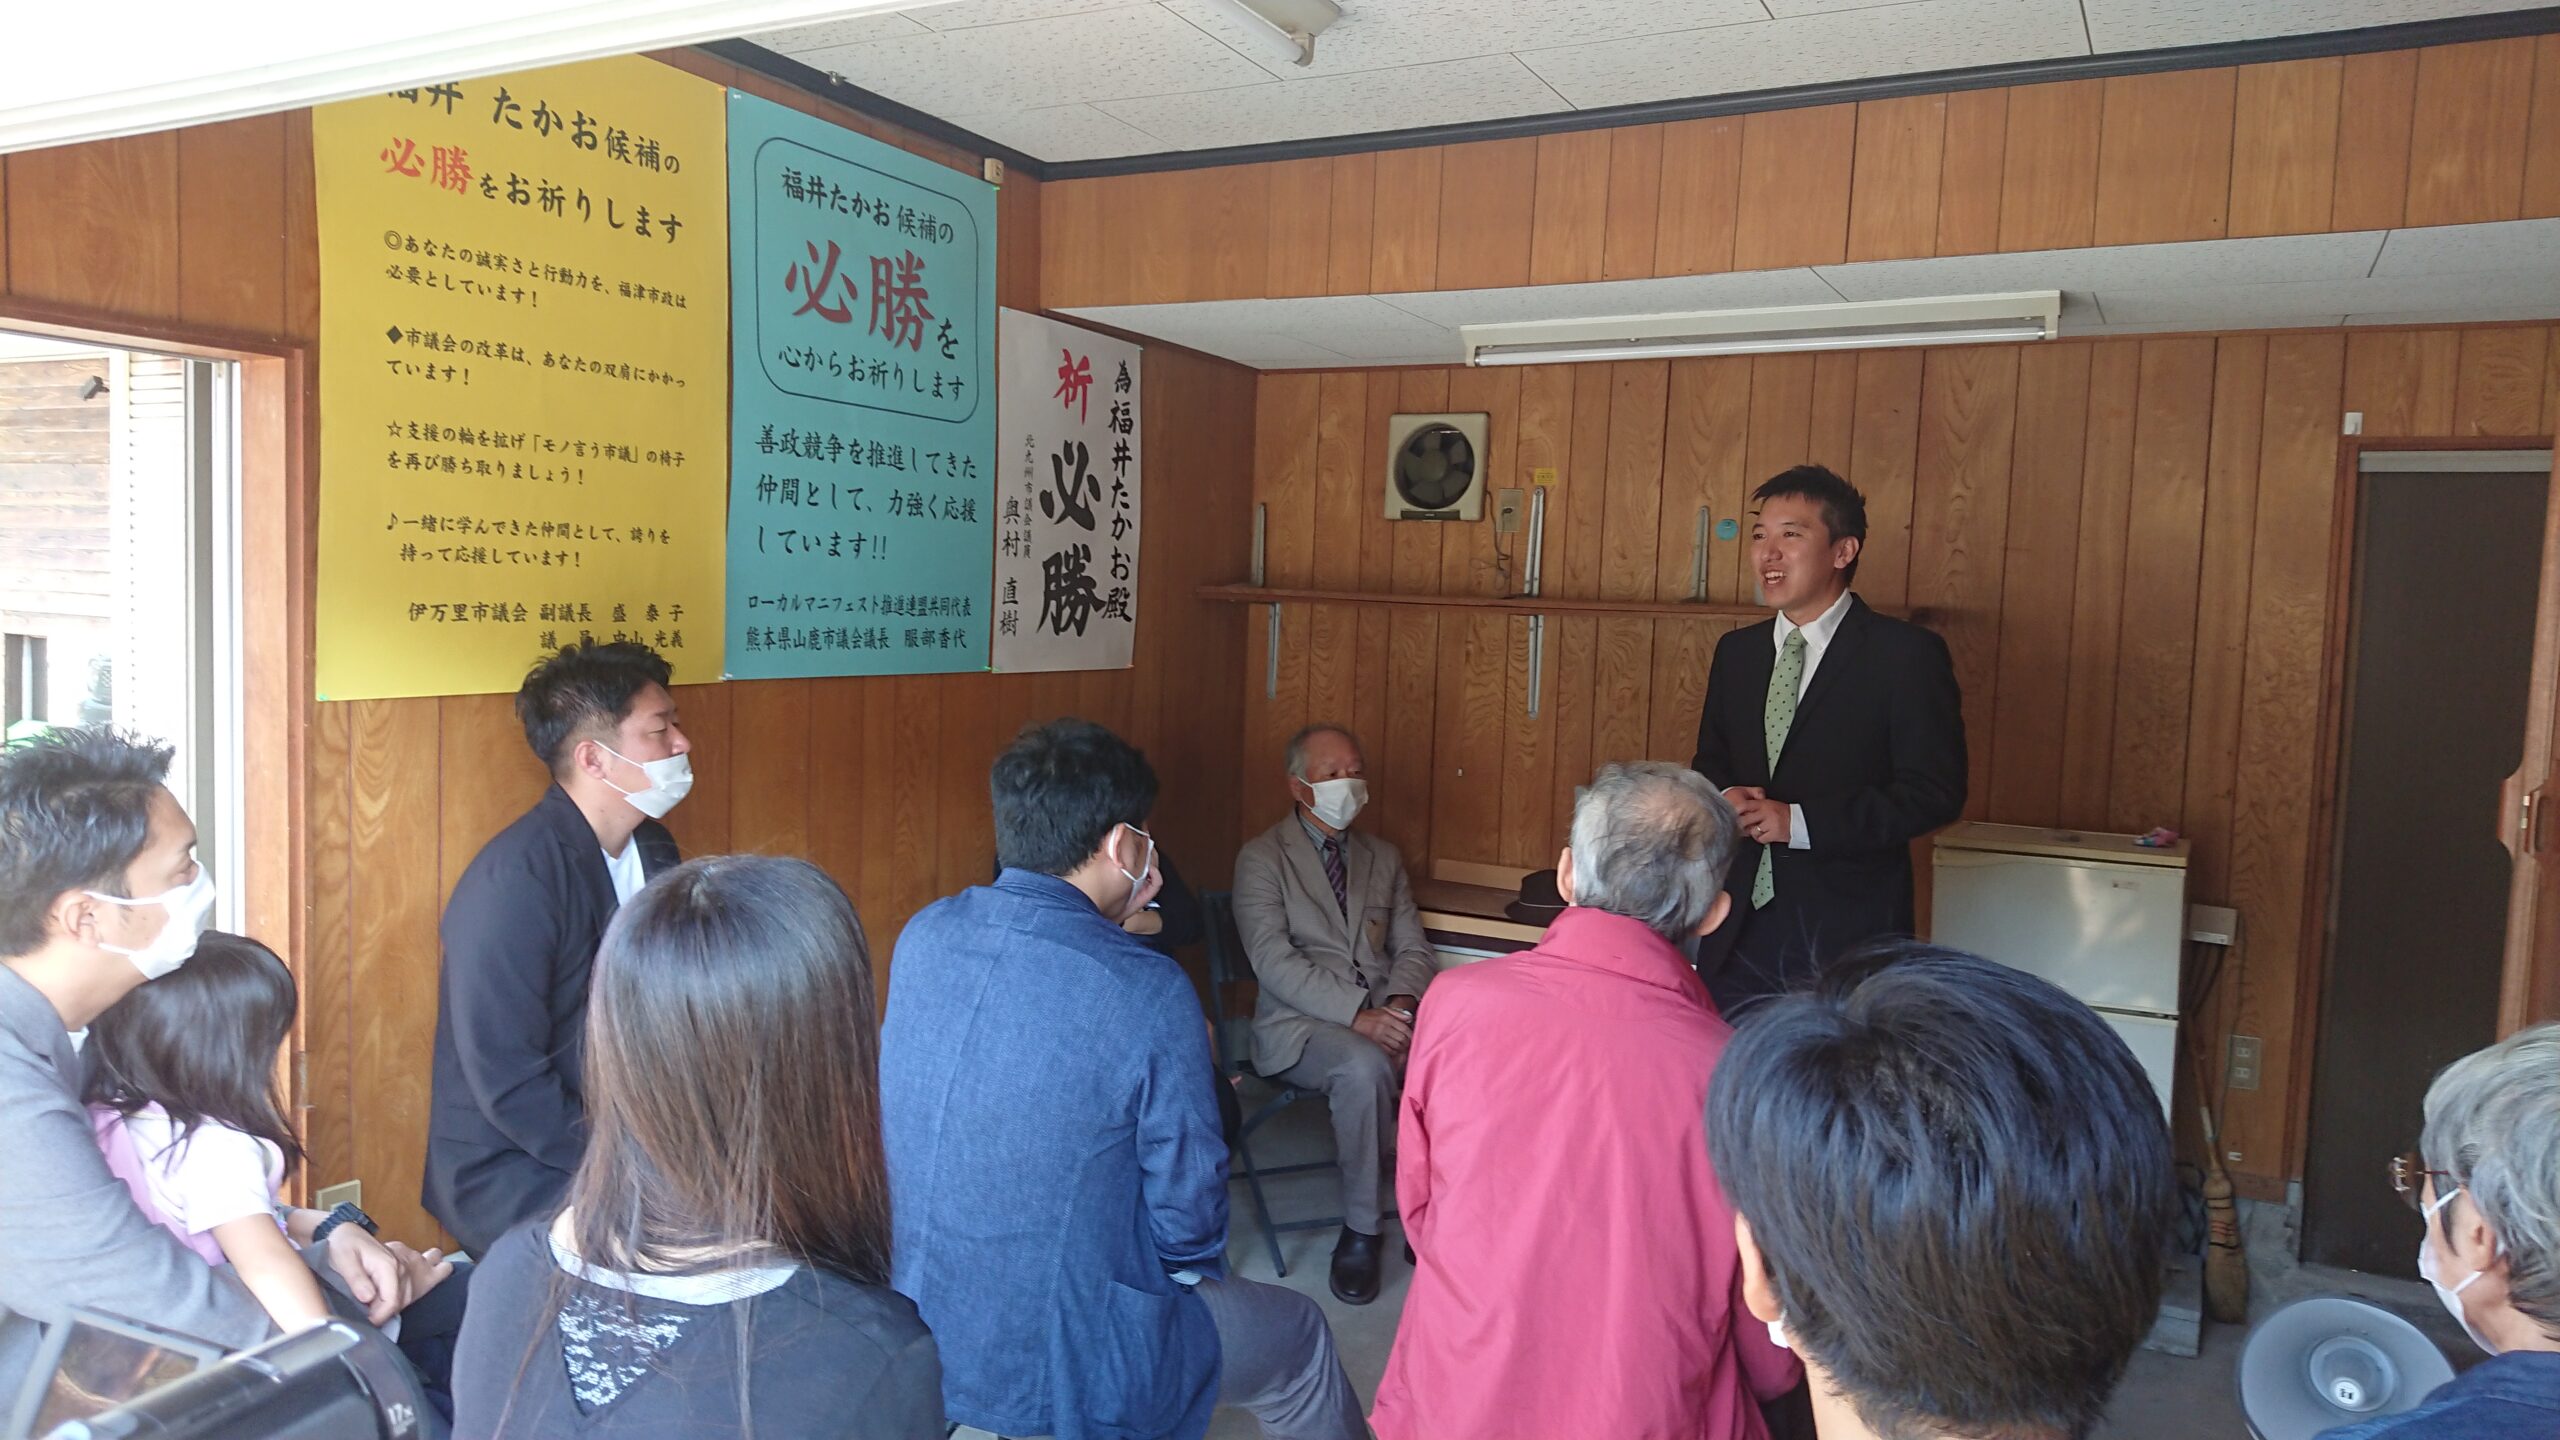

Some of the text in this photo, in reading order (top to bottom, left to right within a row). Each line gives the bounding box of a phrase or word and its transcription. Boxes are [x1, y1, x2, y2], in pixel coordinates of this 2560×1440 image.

[492, 86, 681, 175] たかお候補の
[380, 136, 683, 244] 必勝をお祈りします
[778, 344, 965, 400] 心からお祈りします
[755, 424, 977, 480] 善政競争を推進してきた
[755, 473, 978, 524] 仲間として、力強く応援
[408, 602, 529, 623] 伊万里市議会
[539, 602, 593, 623] 副議長
[748, 593, 972, 618] ローカルマニフェスト推進連盟共同代表
[745, 625, 968, 652] 熊本県山鹿市議会議長 服部香代
